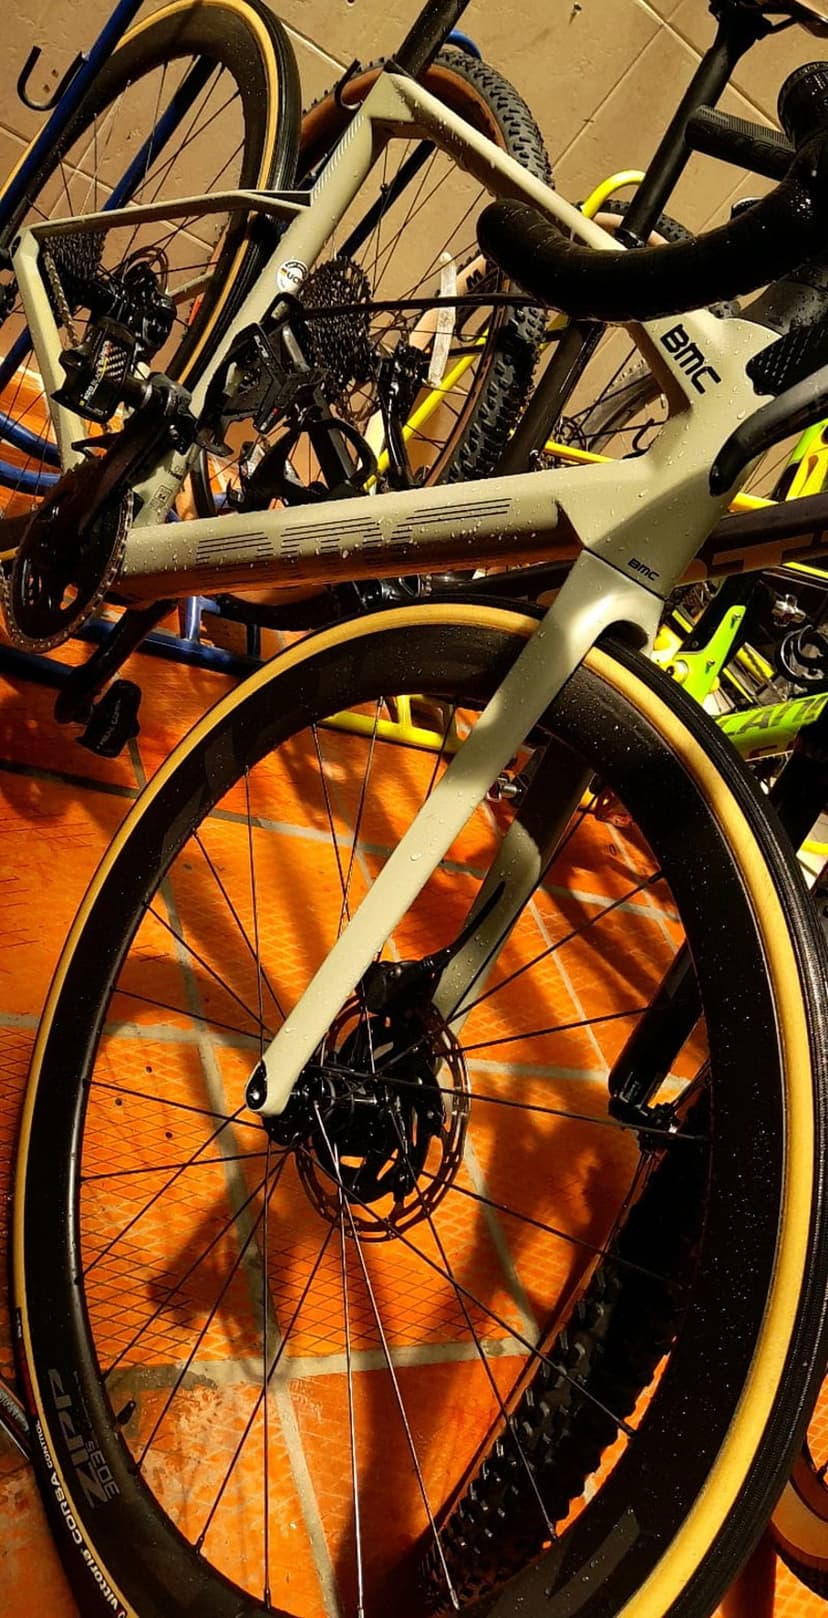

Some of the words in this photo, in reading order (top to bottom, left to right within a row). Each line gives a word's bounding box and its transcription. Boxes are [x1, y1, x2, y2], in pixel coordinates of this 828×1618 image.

[660, 323, 722, 395] BMC
[628, 557, 660, 581] BMC
[35, 1419, 54, 1470] CONTROL
[47, 1368, 109, 1509] ZIPP
[50, 1471, 83, 1545] CORSA
